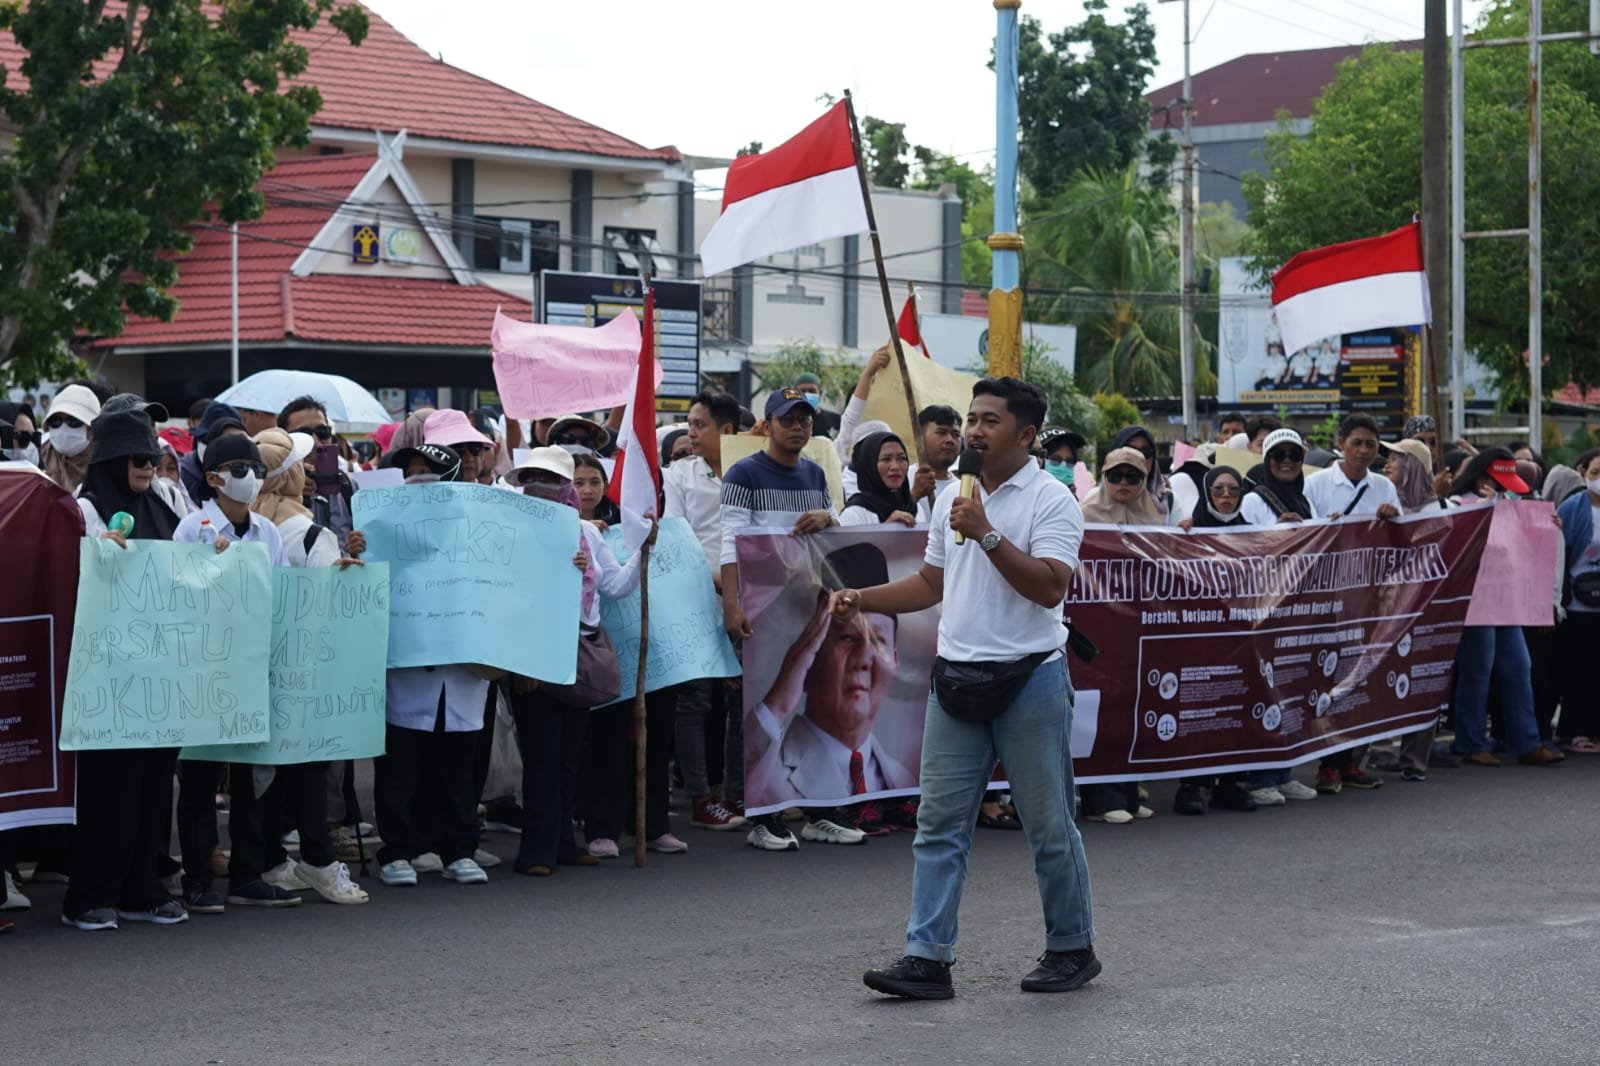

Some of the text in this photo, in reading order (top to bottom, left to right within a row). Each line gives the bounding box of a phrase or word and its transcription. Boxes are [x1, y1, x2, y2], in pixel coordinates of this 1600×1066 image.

[395, 515, 517, 566] UMKM
[1066, 559, 1136, 604] AMAI
[1140, 557, 1232, 602] DUKUNG
[1234, 554, 1282, 599] MBG
[1141, 610, 1180, 625] Bersatu,
[1182, 608, 1226, 625] Berjuang,
[72, 618, 234, 686] BERSATU
[71, 671, 239, 733] DUKUNG
[219, 710, 266, 739] MBG
